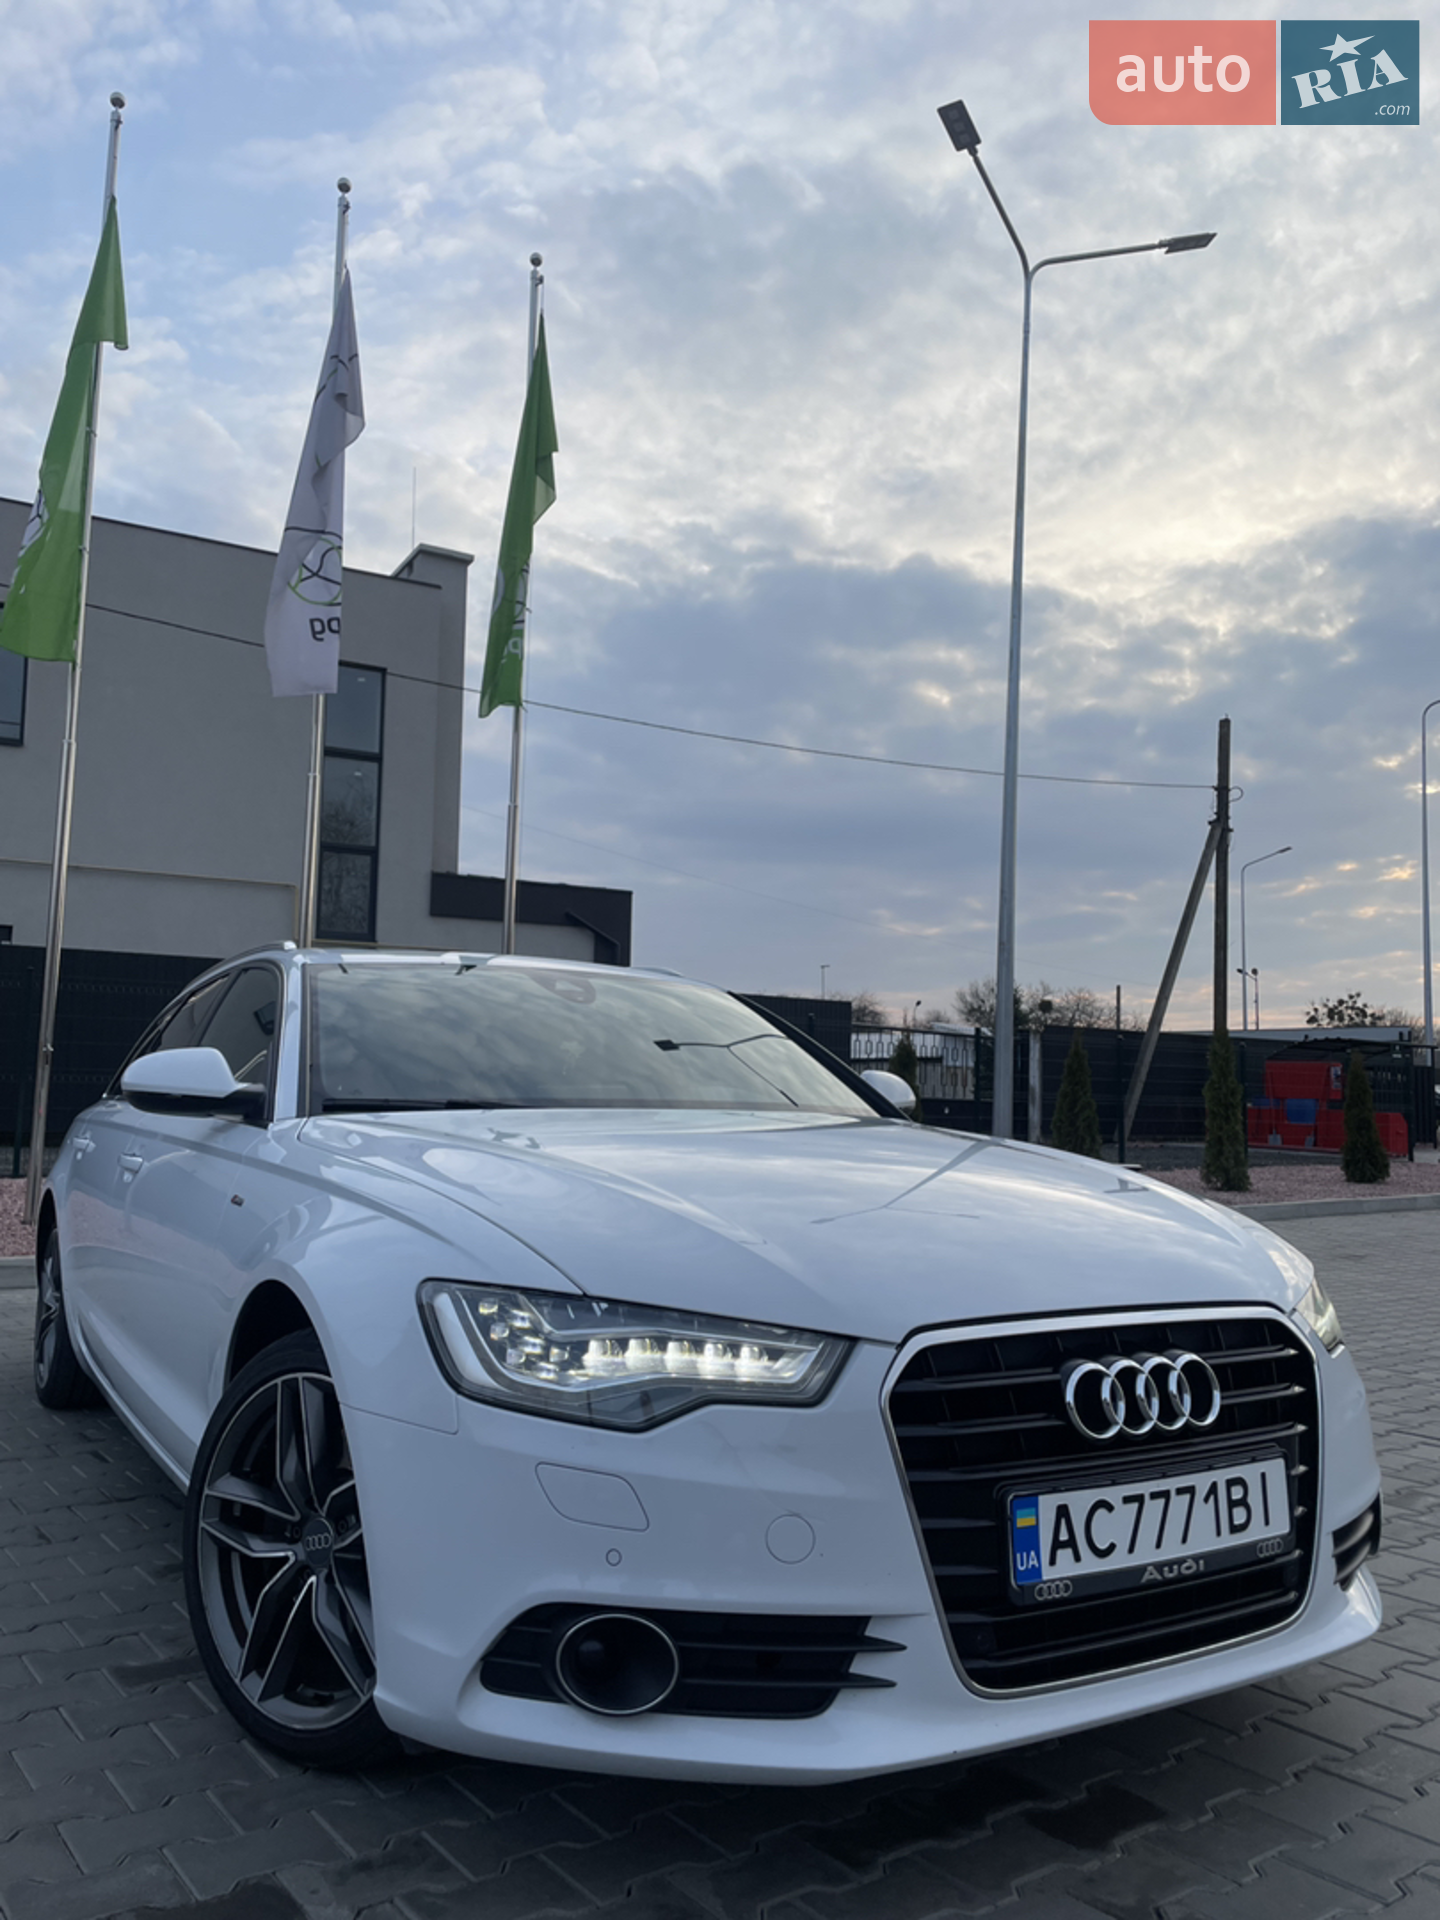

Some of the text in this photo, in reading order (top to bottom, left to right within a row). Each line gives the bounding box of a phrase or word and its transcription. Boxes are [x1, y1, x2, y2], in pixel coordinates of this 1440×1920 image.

[1049, 1471, 1270, 1567] AC7771BI
[1016, 1550, 1039, 1571] UA
[1141, 1559, 1205, 1583] Audi
